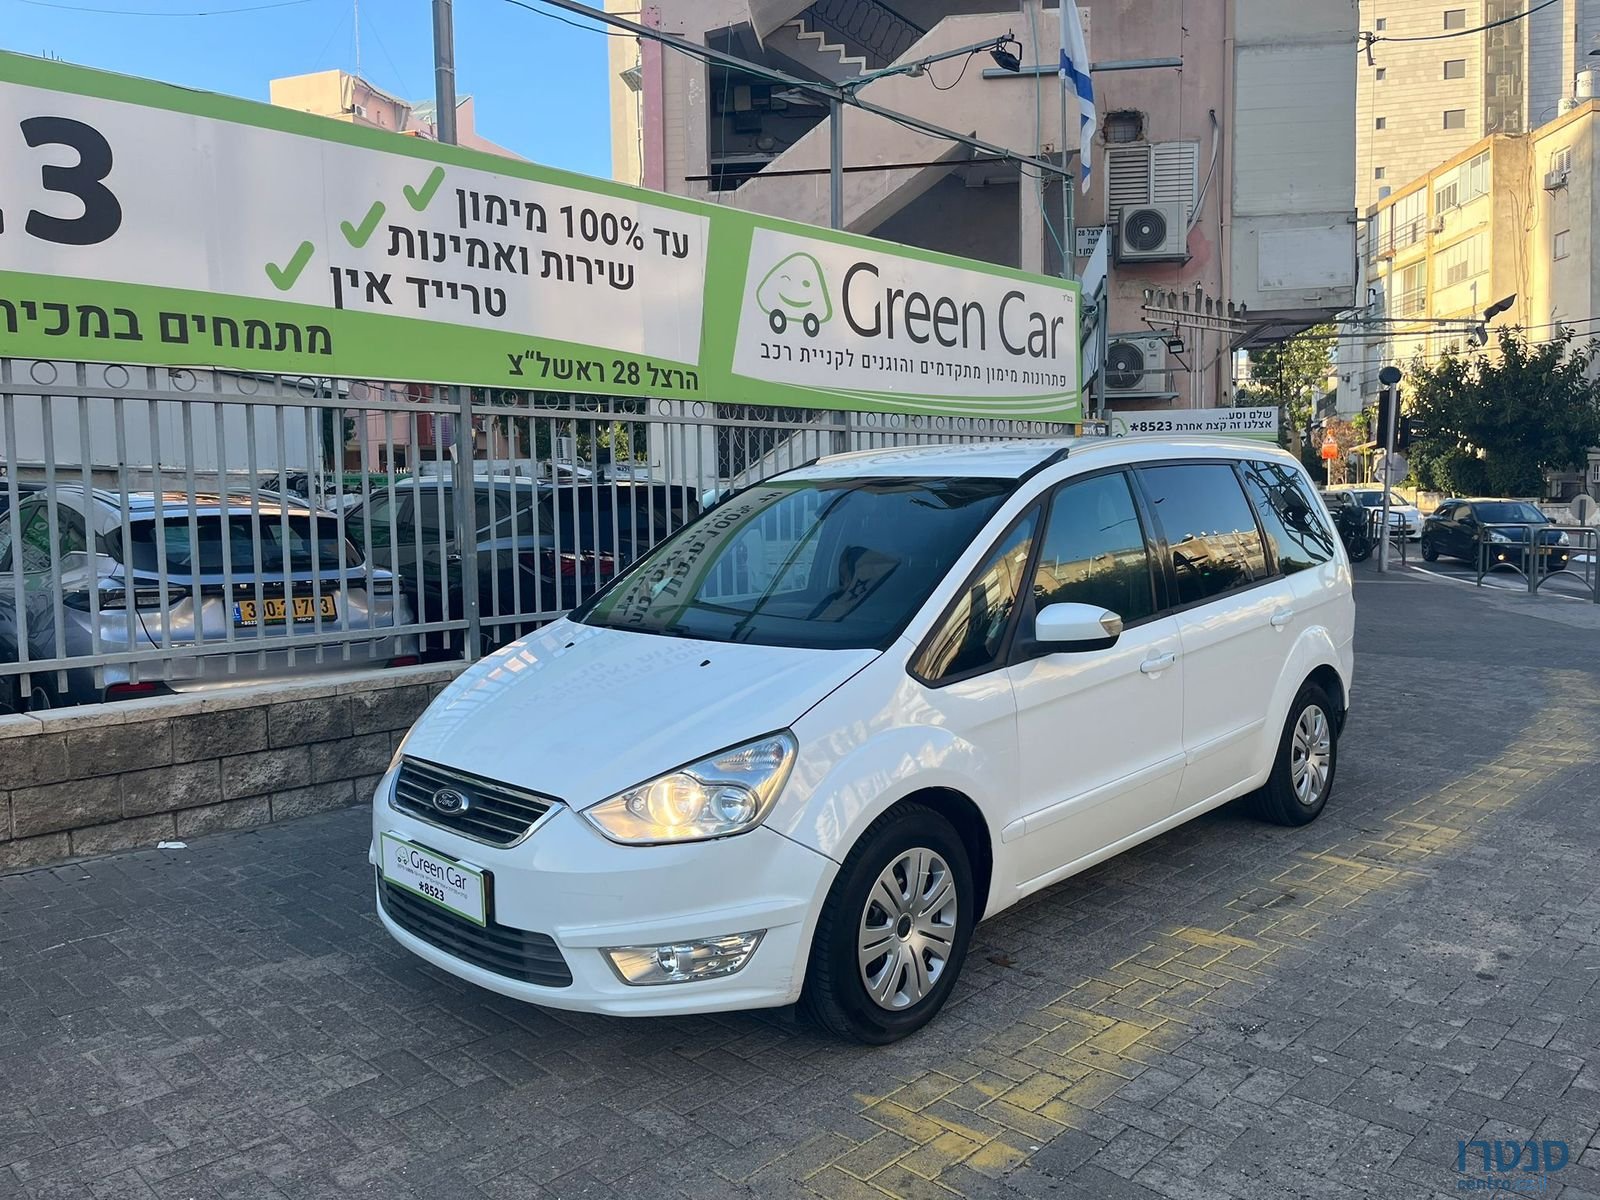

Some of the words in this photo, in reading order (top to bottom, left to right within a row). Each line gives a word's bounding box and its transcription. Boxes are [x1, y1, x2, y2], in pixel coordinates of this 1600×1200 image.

[456, 188, 547, 234] מימון
[560, 205, 644, 251] 100%
[387, 225, 528, 275] ואמינות
[653, 228, 689, 259] עד
[540, 250, 634, 290] שירות
[329, 266, 394, 310] אין
[405, 276, 507, 318] טרייד
[842, 261, 986, 351] Green
[998, 290, 1064, 360] Car
[159, 312, 332, 355] מתמחים
[761, 343, 791, 361] רכב
[800, 347, 854, 370] לקניית
[862, 354, 914, 373] והוגנים
[612, 360, 641, 385] 28
[646, 362, 698, 390] הרצל
[921, 360, 981, 381] מתקדמים
[986, 367, 1018, 384] מימון
[1022, 371, 1066, 387] פתרונות
[1176, 423, 1203, 431] אחרת
[1206, 422, 1227, 432] קצת
[1230, 421, 1240, 430] זה
[1244, 420, 1272, 429] אצלנו
[1249, 410, 1272, 420] שלם
[410, 850, 444, 880] Green
[446, 866, 467, 890] Car
